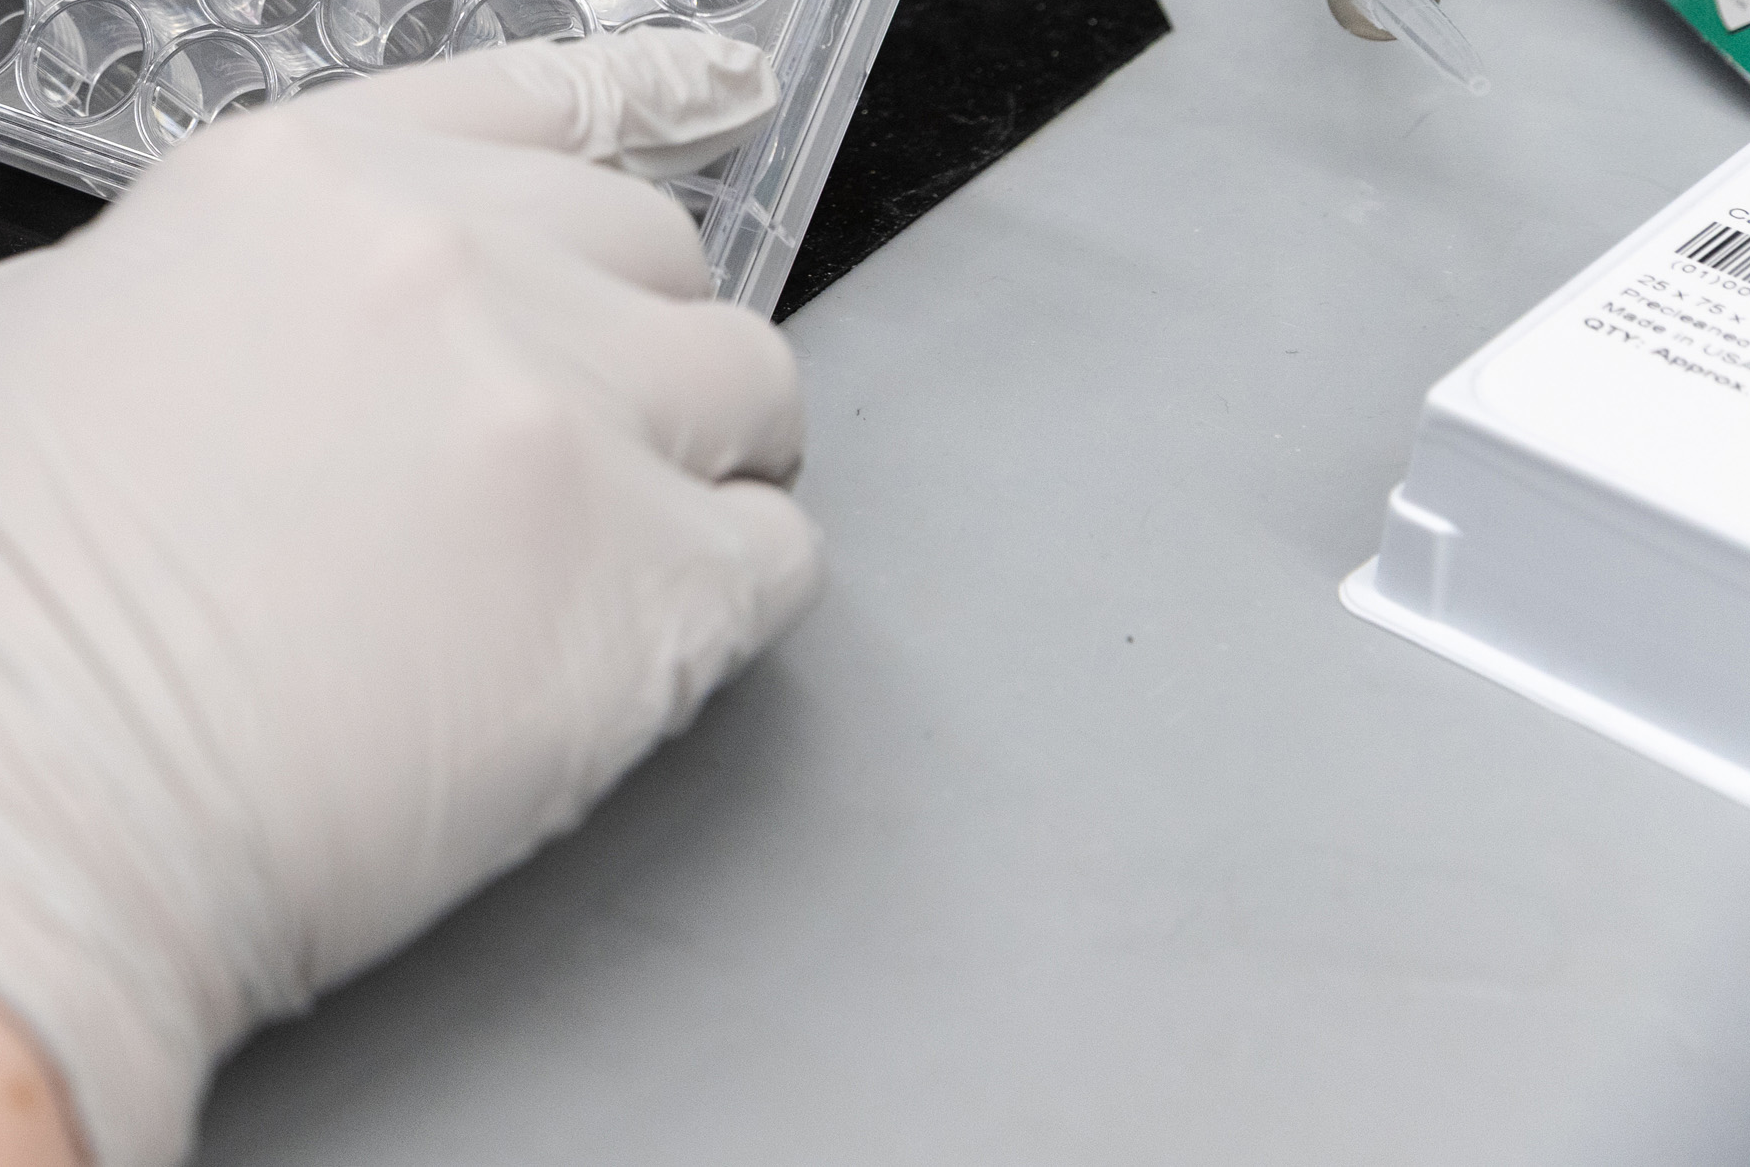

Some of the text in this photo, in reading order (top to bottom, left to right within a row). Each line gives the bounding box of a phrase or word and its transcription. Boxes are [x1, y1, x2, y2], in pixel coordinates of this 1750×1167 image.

[1636, 274, 1670, 292] 25
[1696, 296, 1727, 315] 75
[1602, 300, 1667, 334] Made
